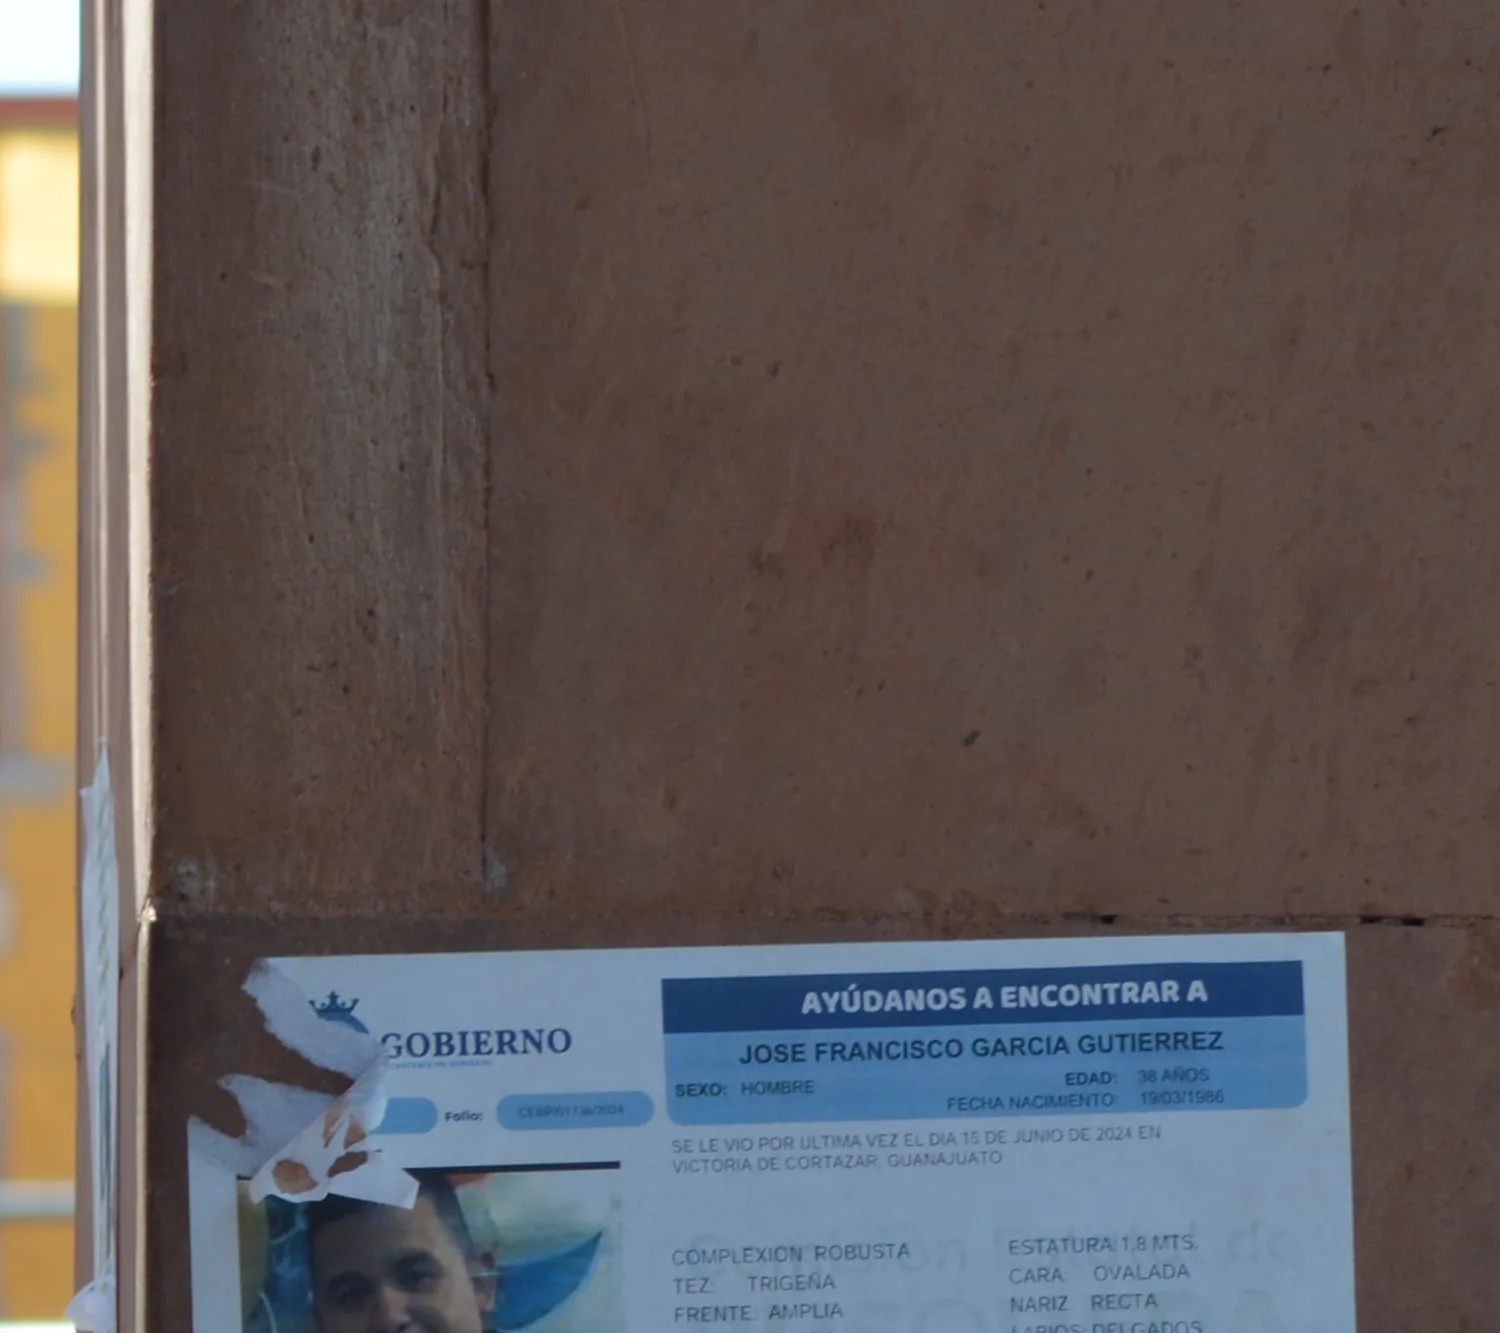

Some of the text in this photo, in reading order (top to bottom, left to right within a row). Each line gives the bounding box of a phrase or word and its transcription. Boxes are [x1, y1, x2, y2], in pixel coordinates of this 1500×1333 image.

[801, 980, 1209, 1014] AYÚDANOS A ENCONTRAR A
[380, 1027, 573, 1059] GOBIERNO
[739, 1031, 1225, 1065] JOSE FRANCISCO GARCIA GUTIERREZ
[674, 1080, 815, 1098] SEXO: HOMBRE
[1064, 1067, 1210, 1087] EDAD: 38 AÑOS
[444, 1110, 483, 1122] Folio:
[947, 1096, 1006, 1112] FECHA
[672, 1125, 1161, 1154] SE LE VIO POR ULTIMA VEZ EL DIA 15 DE JUNIO DE 2024 EN
[672, 1158, 753, 1174] VICTORIA
[757, 1156, 781, 1172] DE
[887, 1150, 1004, 1168] GUANAJUATO
